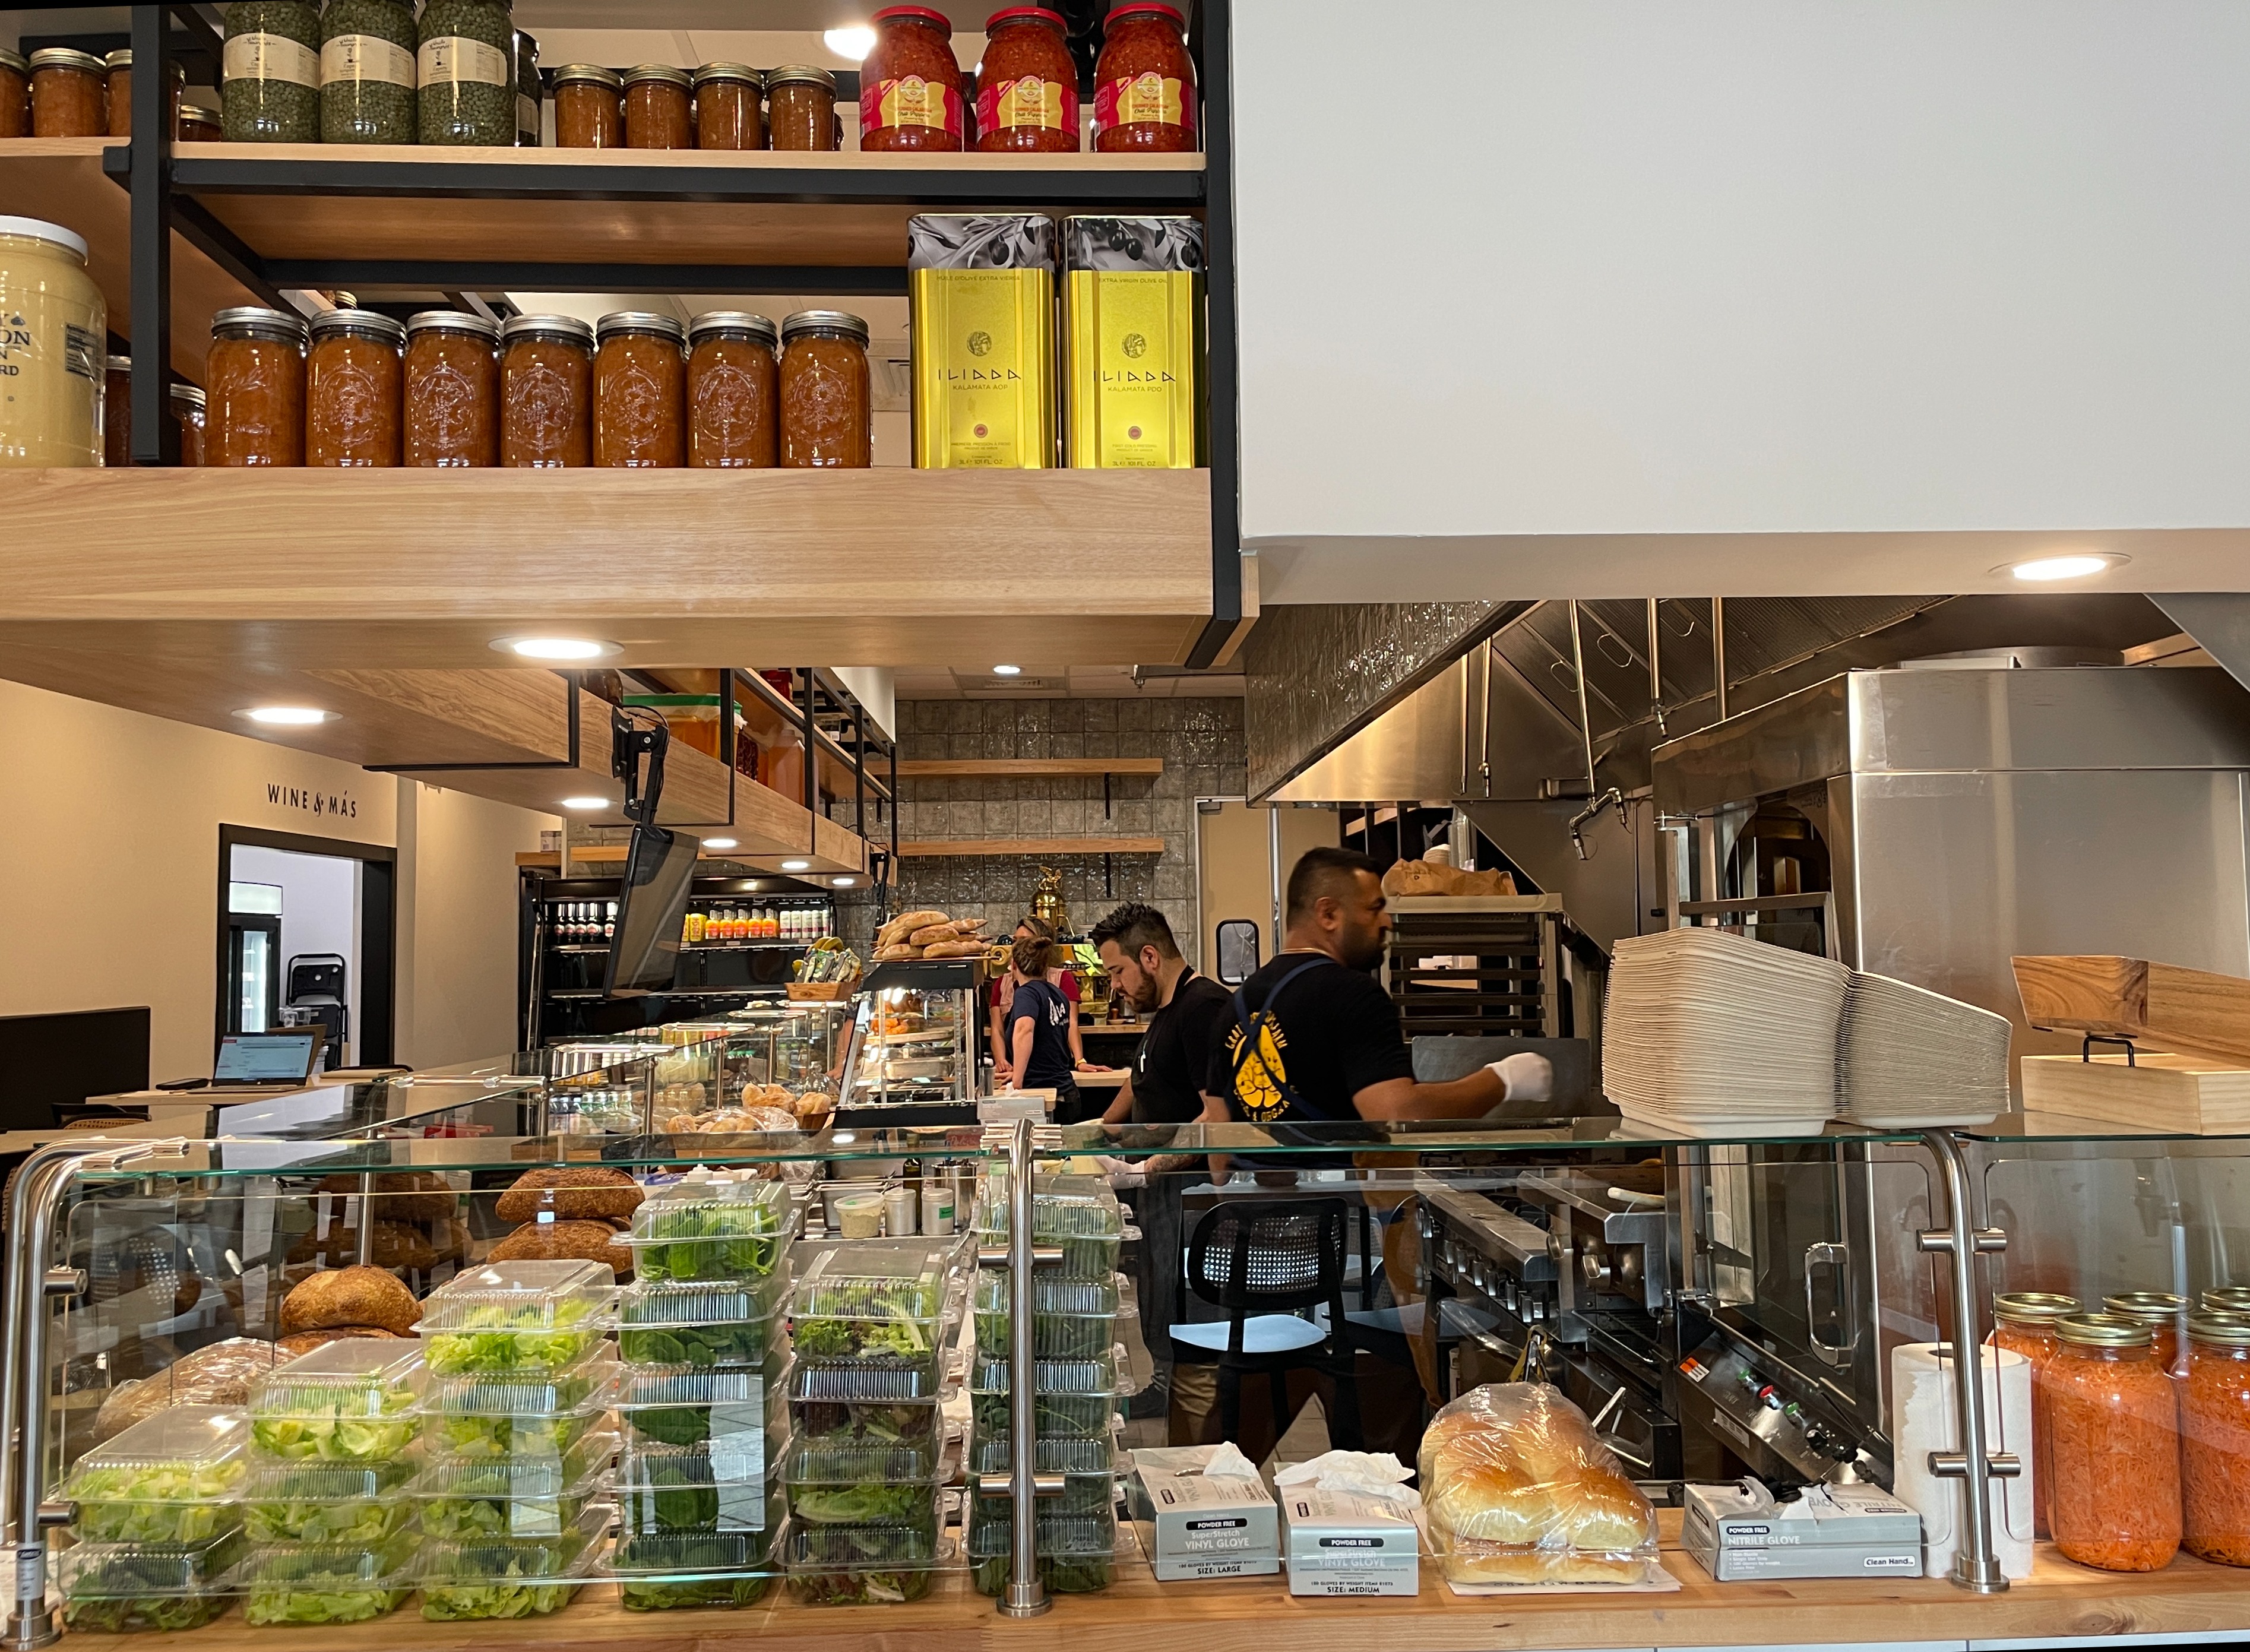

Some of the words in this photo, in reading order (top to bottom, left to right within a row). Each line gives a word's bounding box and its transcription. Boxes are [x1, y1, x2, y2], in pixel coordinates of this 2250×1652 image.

[938, 368, 1021, 380] ILIADA
[1094, 371, 1176, 382] ILIADA
[268, 783, 308, 809] WINE
[314, 792, 324, 818] &
[329, 790, 356, 818] MÁS
[1191, 1530, 1240, 1539] SuperStretch
[1185, 1540, 1213, 1550] VINYL
[1217, 1537, 1249, 1548] GLOVE
[1728, 1536, 1765, 1545] NITRILE
[1767, 1536, 1800, 1545] GLOVE
[1351, 1558, 1386, 1566] GLOVE
